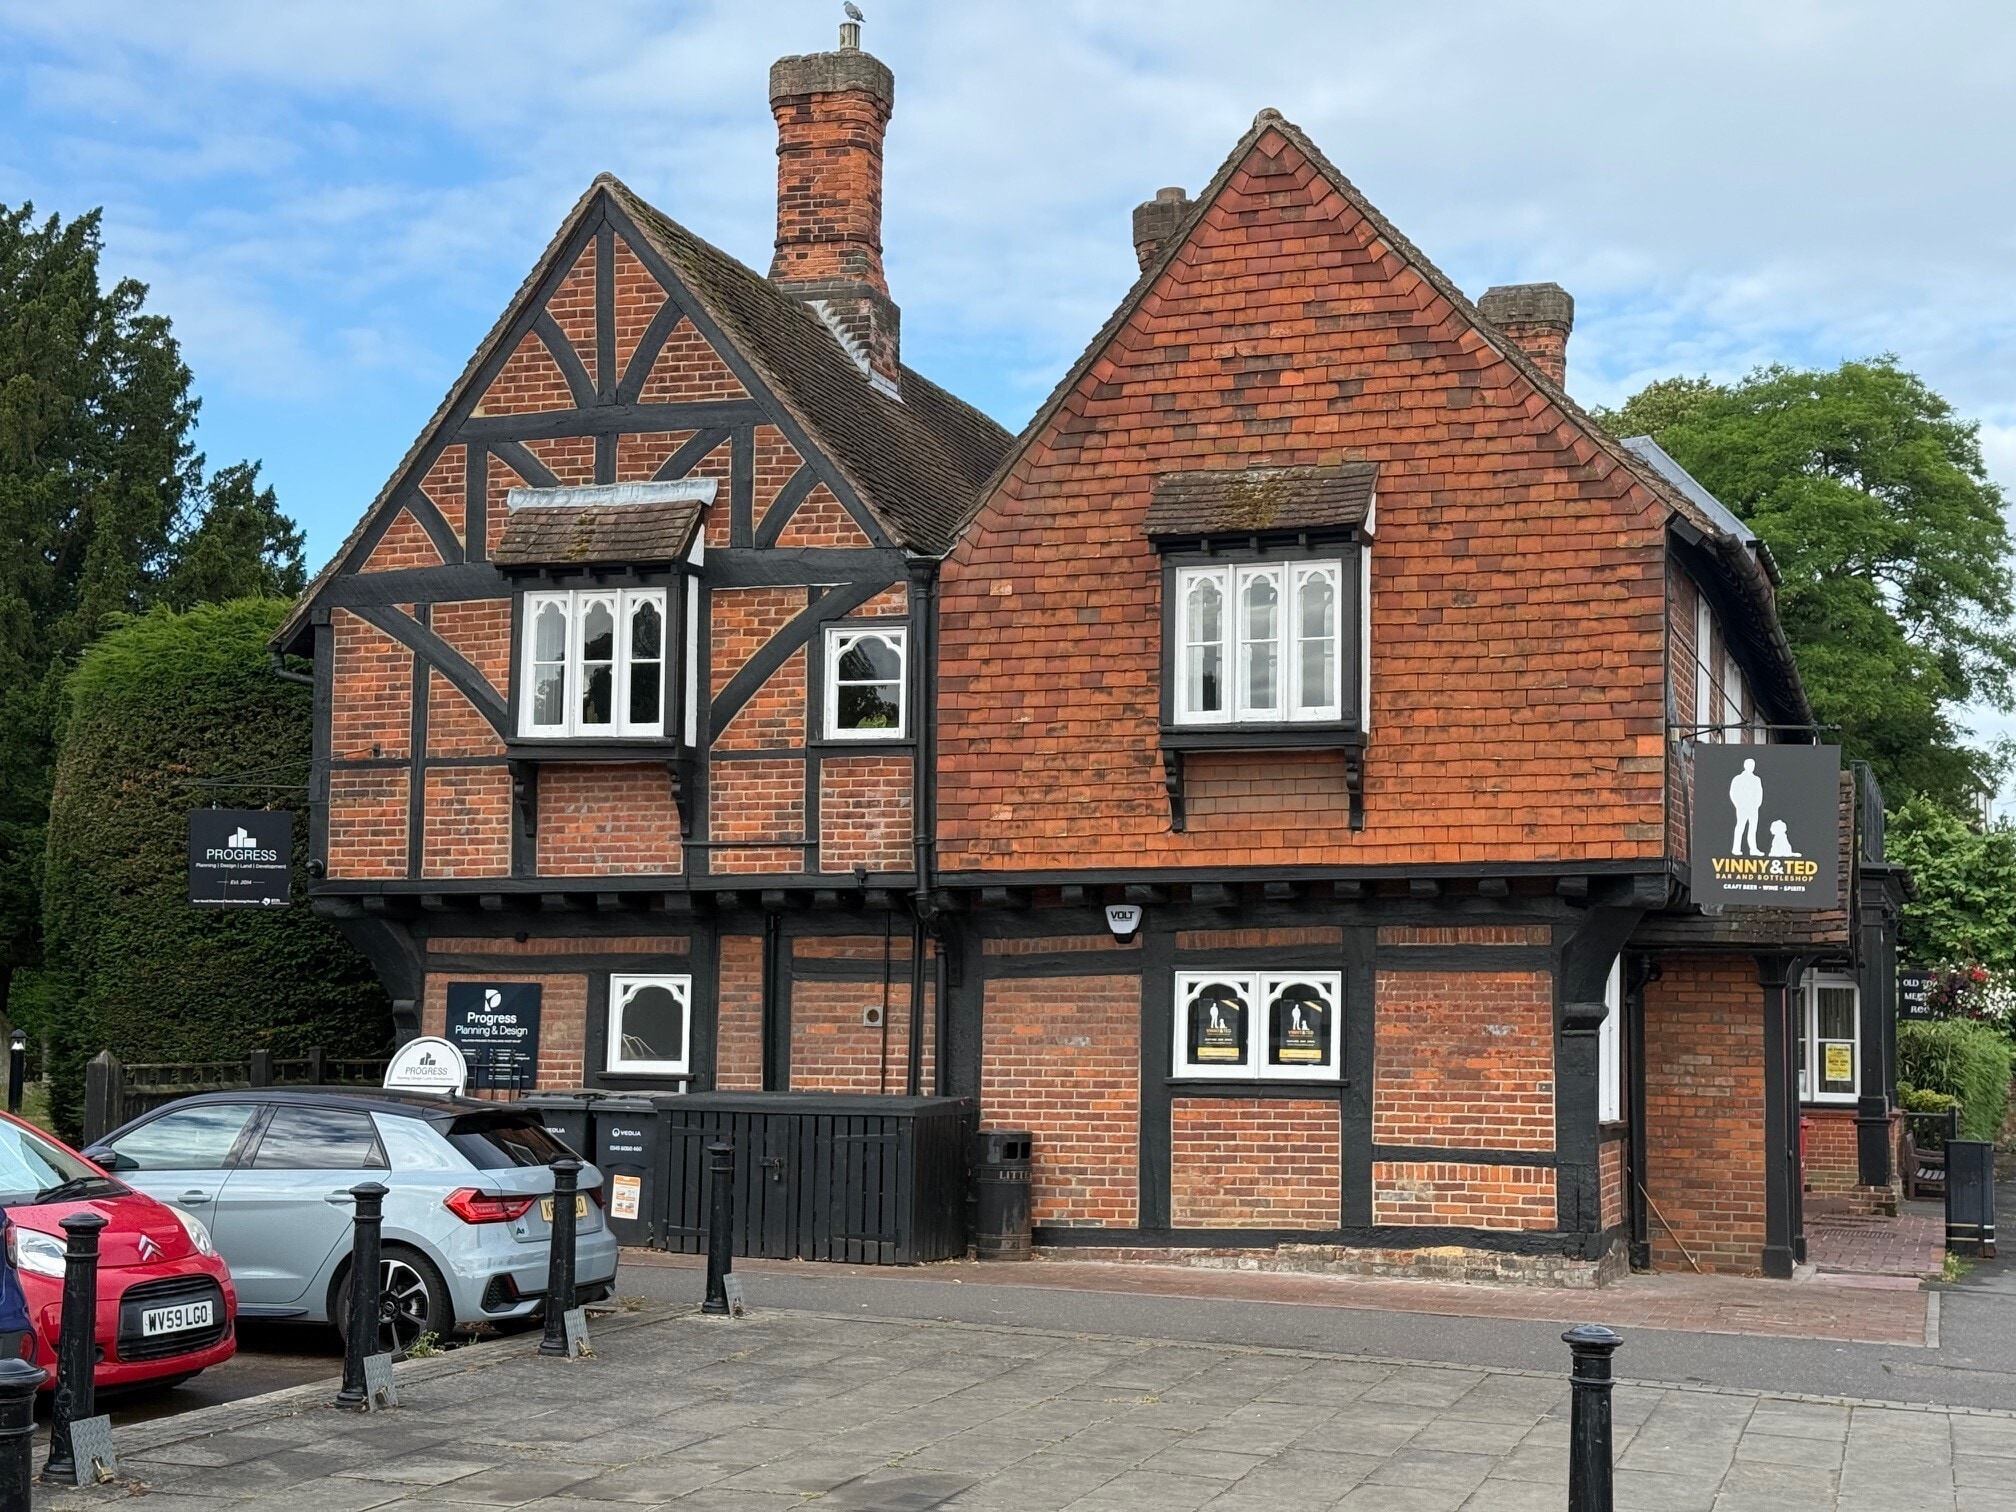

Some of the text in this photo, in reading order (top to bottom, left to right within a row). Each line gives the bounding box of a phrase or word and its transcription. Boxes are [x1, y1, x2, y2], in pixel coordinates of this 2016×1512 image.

[206, 848, 277, 861] PROGRESS
[1711, 858, 1818, 875] VINNY&TED
[1736, 873, 1754, 881] AND
[1757, 874, 1814, 882] BOTTLESHOP
[1110, 910, 1135, 919] VOLT
[1902, 978, 1920, 988] OLD
[467, 1012, 518, 1026] Progress
[455, 1025, 528, 1038] Planning & Design
[405, 1066, 448, 1076] PROGRESS
[1000, 1170, 1031, 1180] LITTE
[149, 1305, 208, 1332] WV59 LGO
